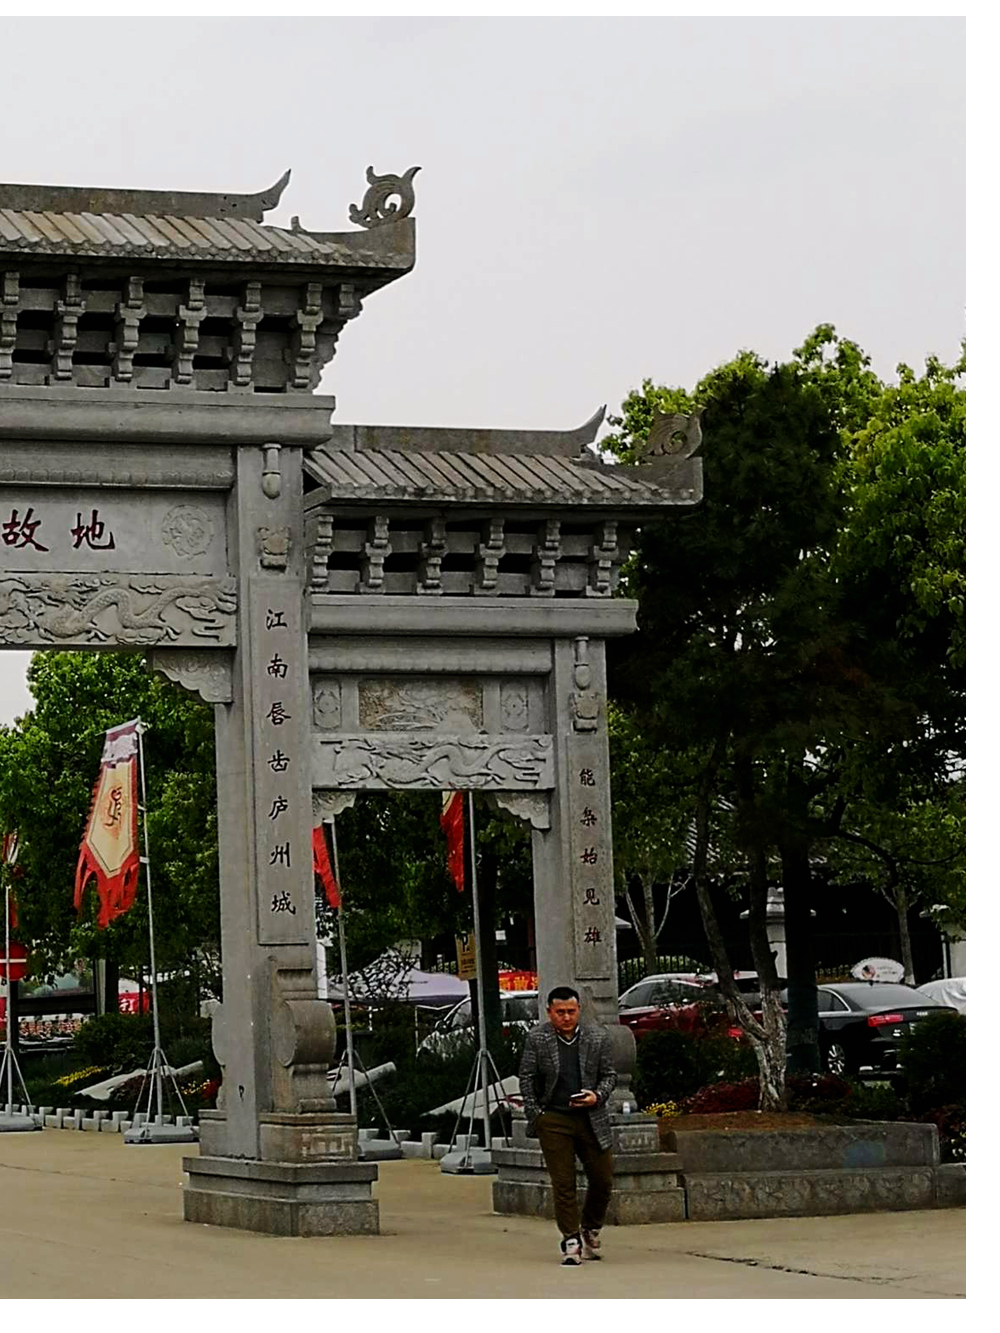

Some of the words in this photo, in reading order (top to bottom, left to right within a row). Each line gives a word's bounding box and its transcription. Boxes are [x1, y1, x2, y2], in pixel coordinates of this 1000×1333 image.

[265, 607, 297, 915] 江南唇齿庐州城
